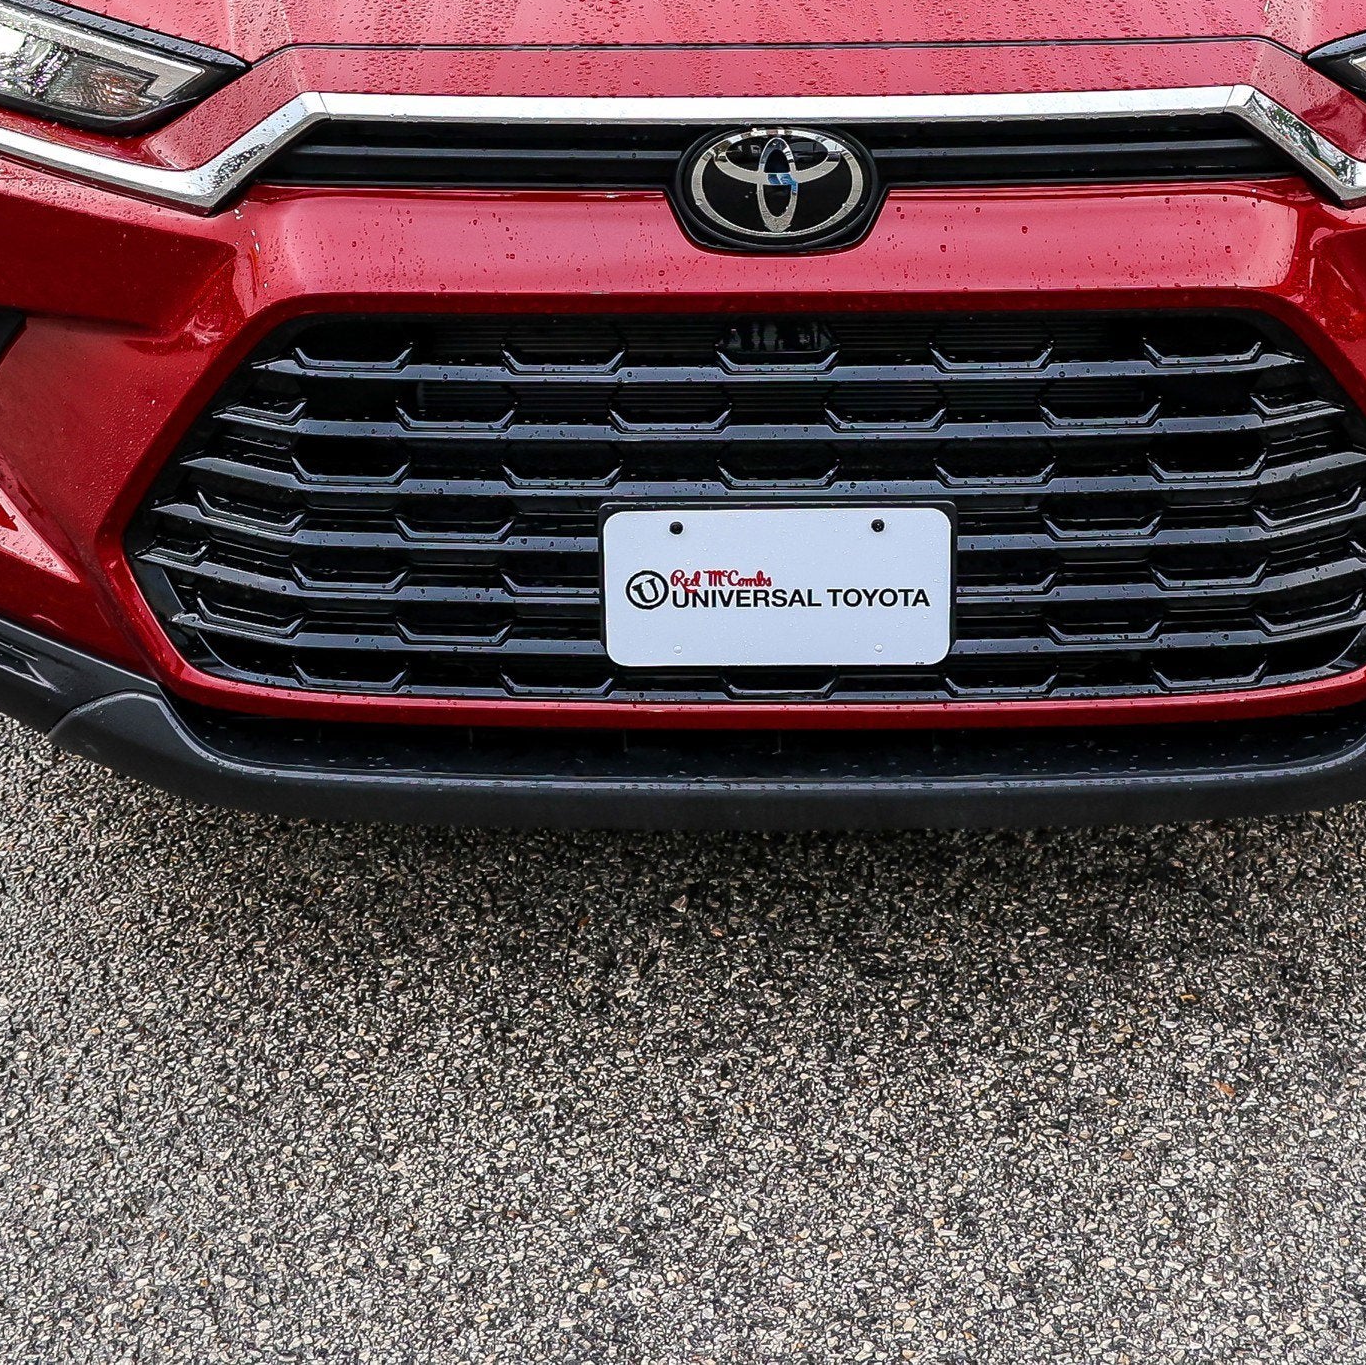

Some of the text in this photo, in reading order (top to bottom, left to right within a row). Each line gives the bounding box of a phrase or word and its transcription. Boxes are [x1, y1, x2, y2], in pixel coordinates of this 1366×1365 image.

[670, 569, 773, 594] Red McCombs
[672, 587, 931, 609] UNIVERSAL TOYOTA
